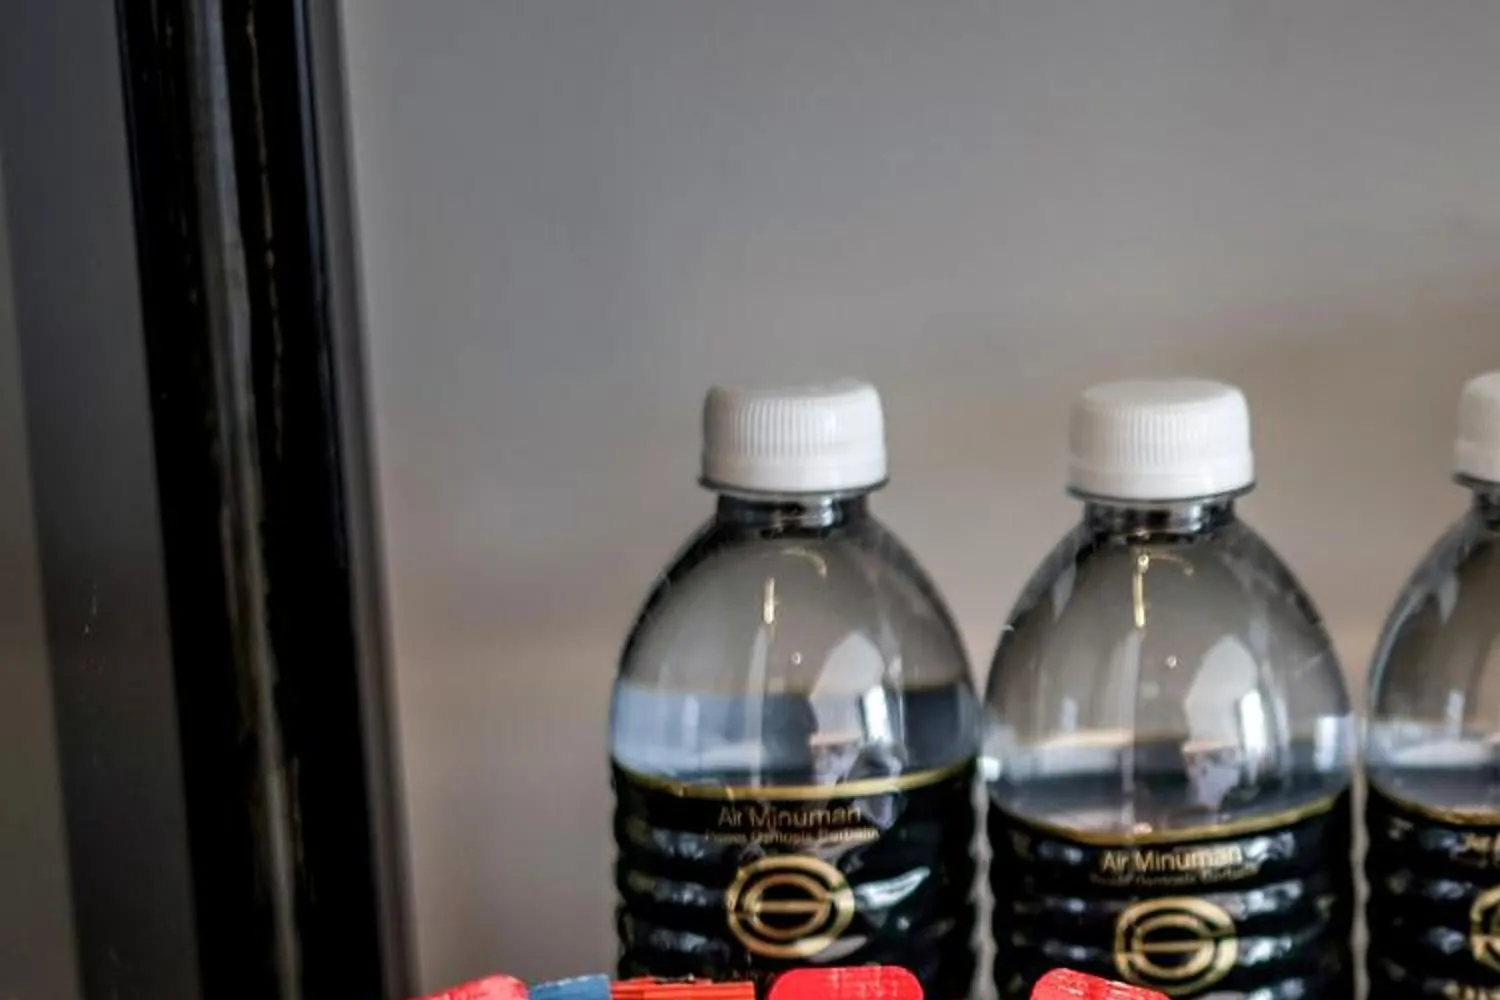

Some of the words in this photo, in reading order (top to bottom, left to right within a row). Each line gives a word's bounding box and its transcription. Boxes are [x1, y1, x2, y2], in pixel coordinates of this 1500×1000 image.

[718, 805, 742, 826] Air
[749, 803, 862, 827] Minuman
[1102, 850, 1129, 871] Air
[1135, 845, 1242, 872] Minuman
